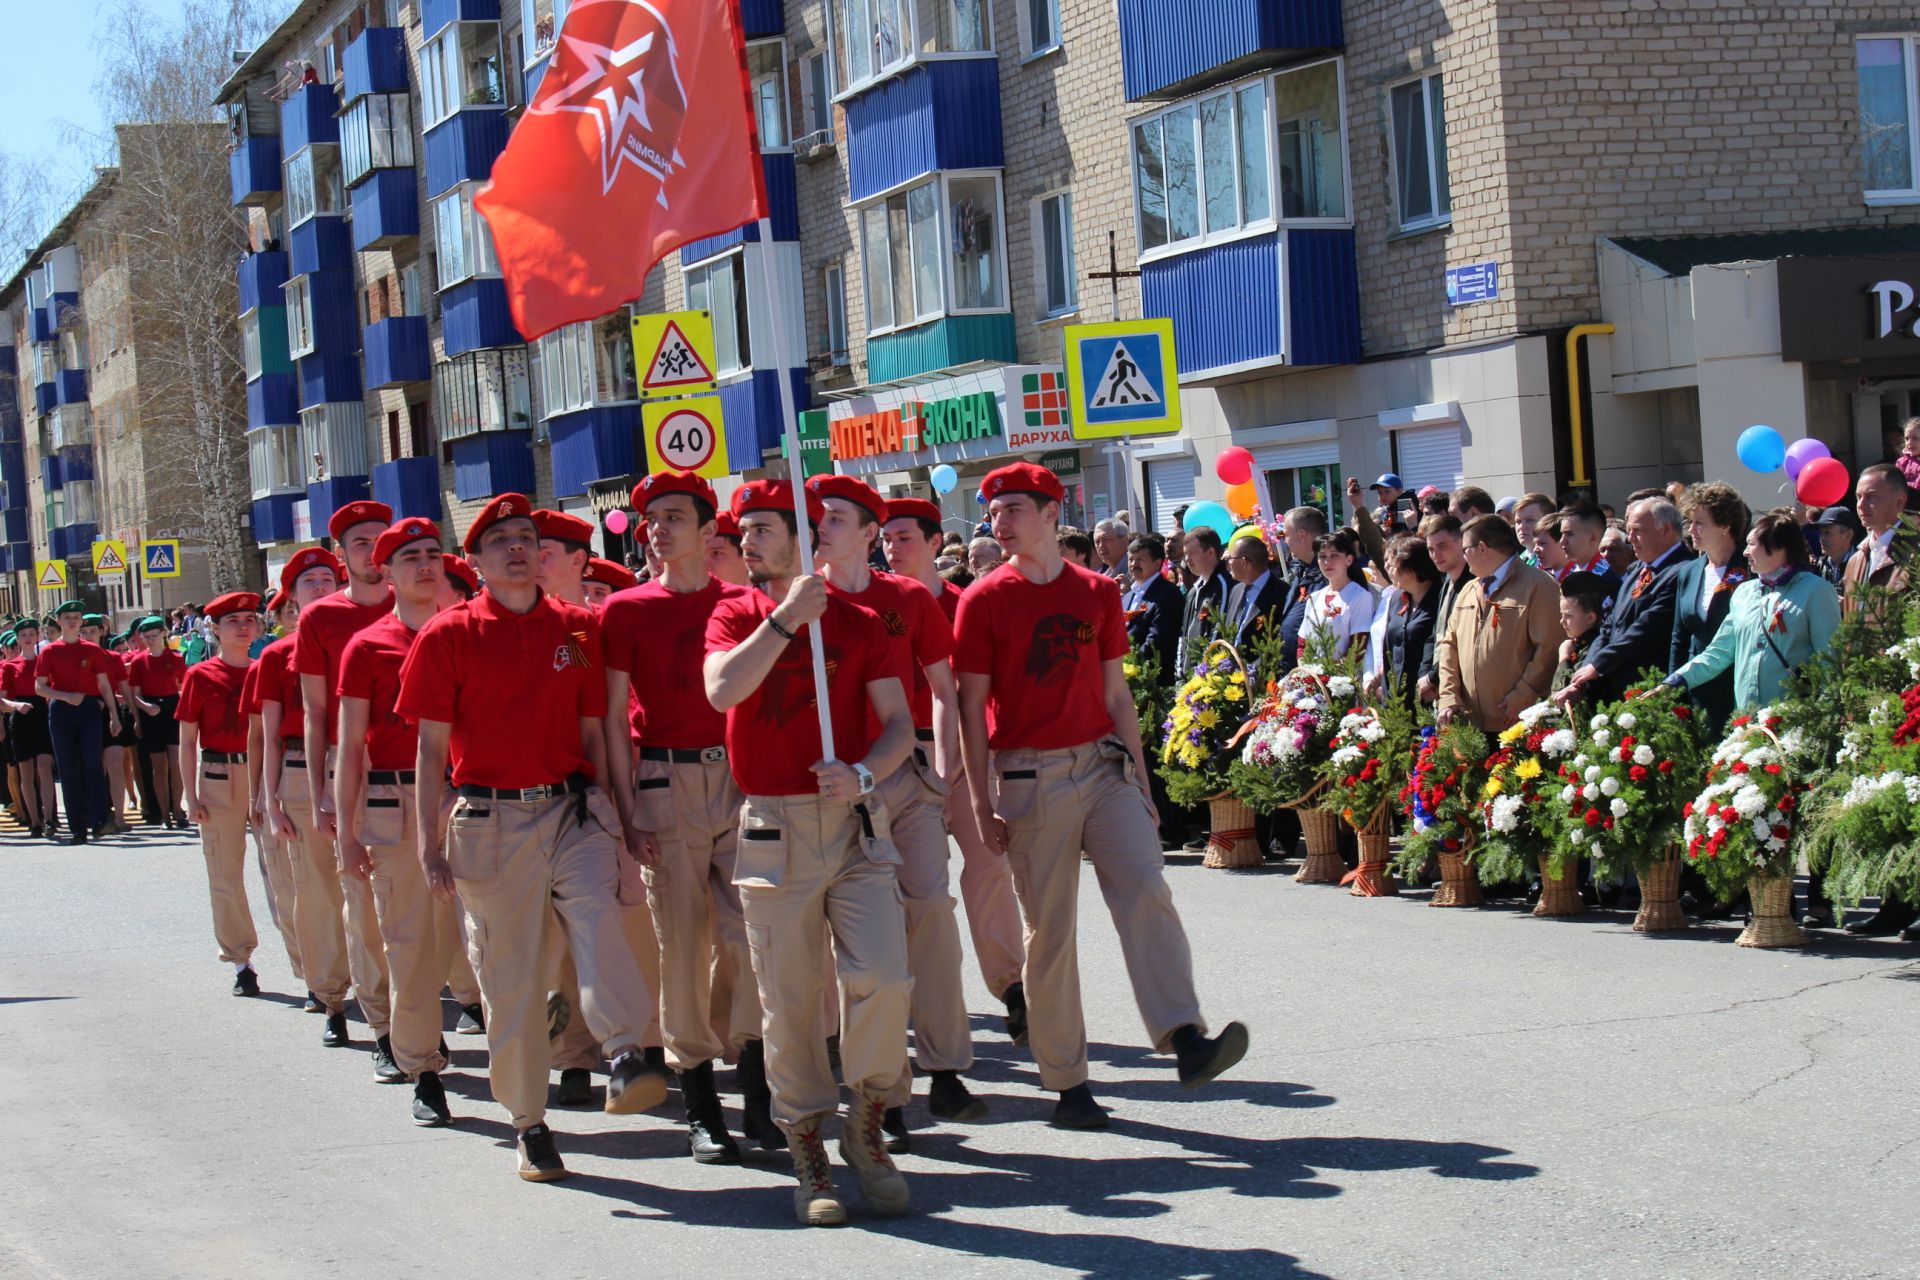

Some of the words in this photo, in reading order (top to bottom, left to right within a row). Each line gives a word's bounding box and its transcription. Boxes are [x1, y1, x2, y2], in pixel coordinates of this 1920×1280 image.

[1487, 271, 1494, 289] 2
[829, 410, 901, 461] АПТЕКА
[921, 391, 994, 446] ЭКОНА
[668, 427, 703, 453] 40
[1009, 430, 1071, 448] ДАРУХА
